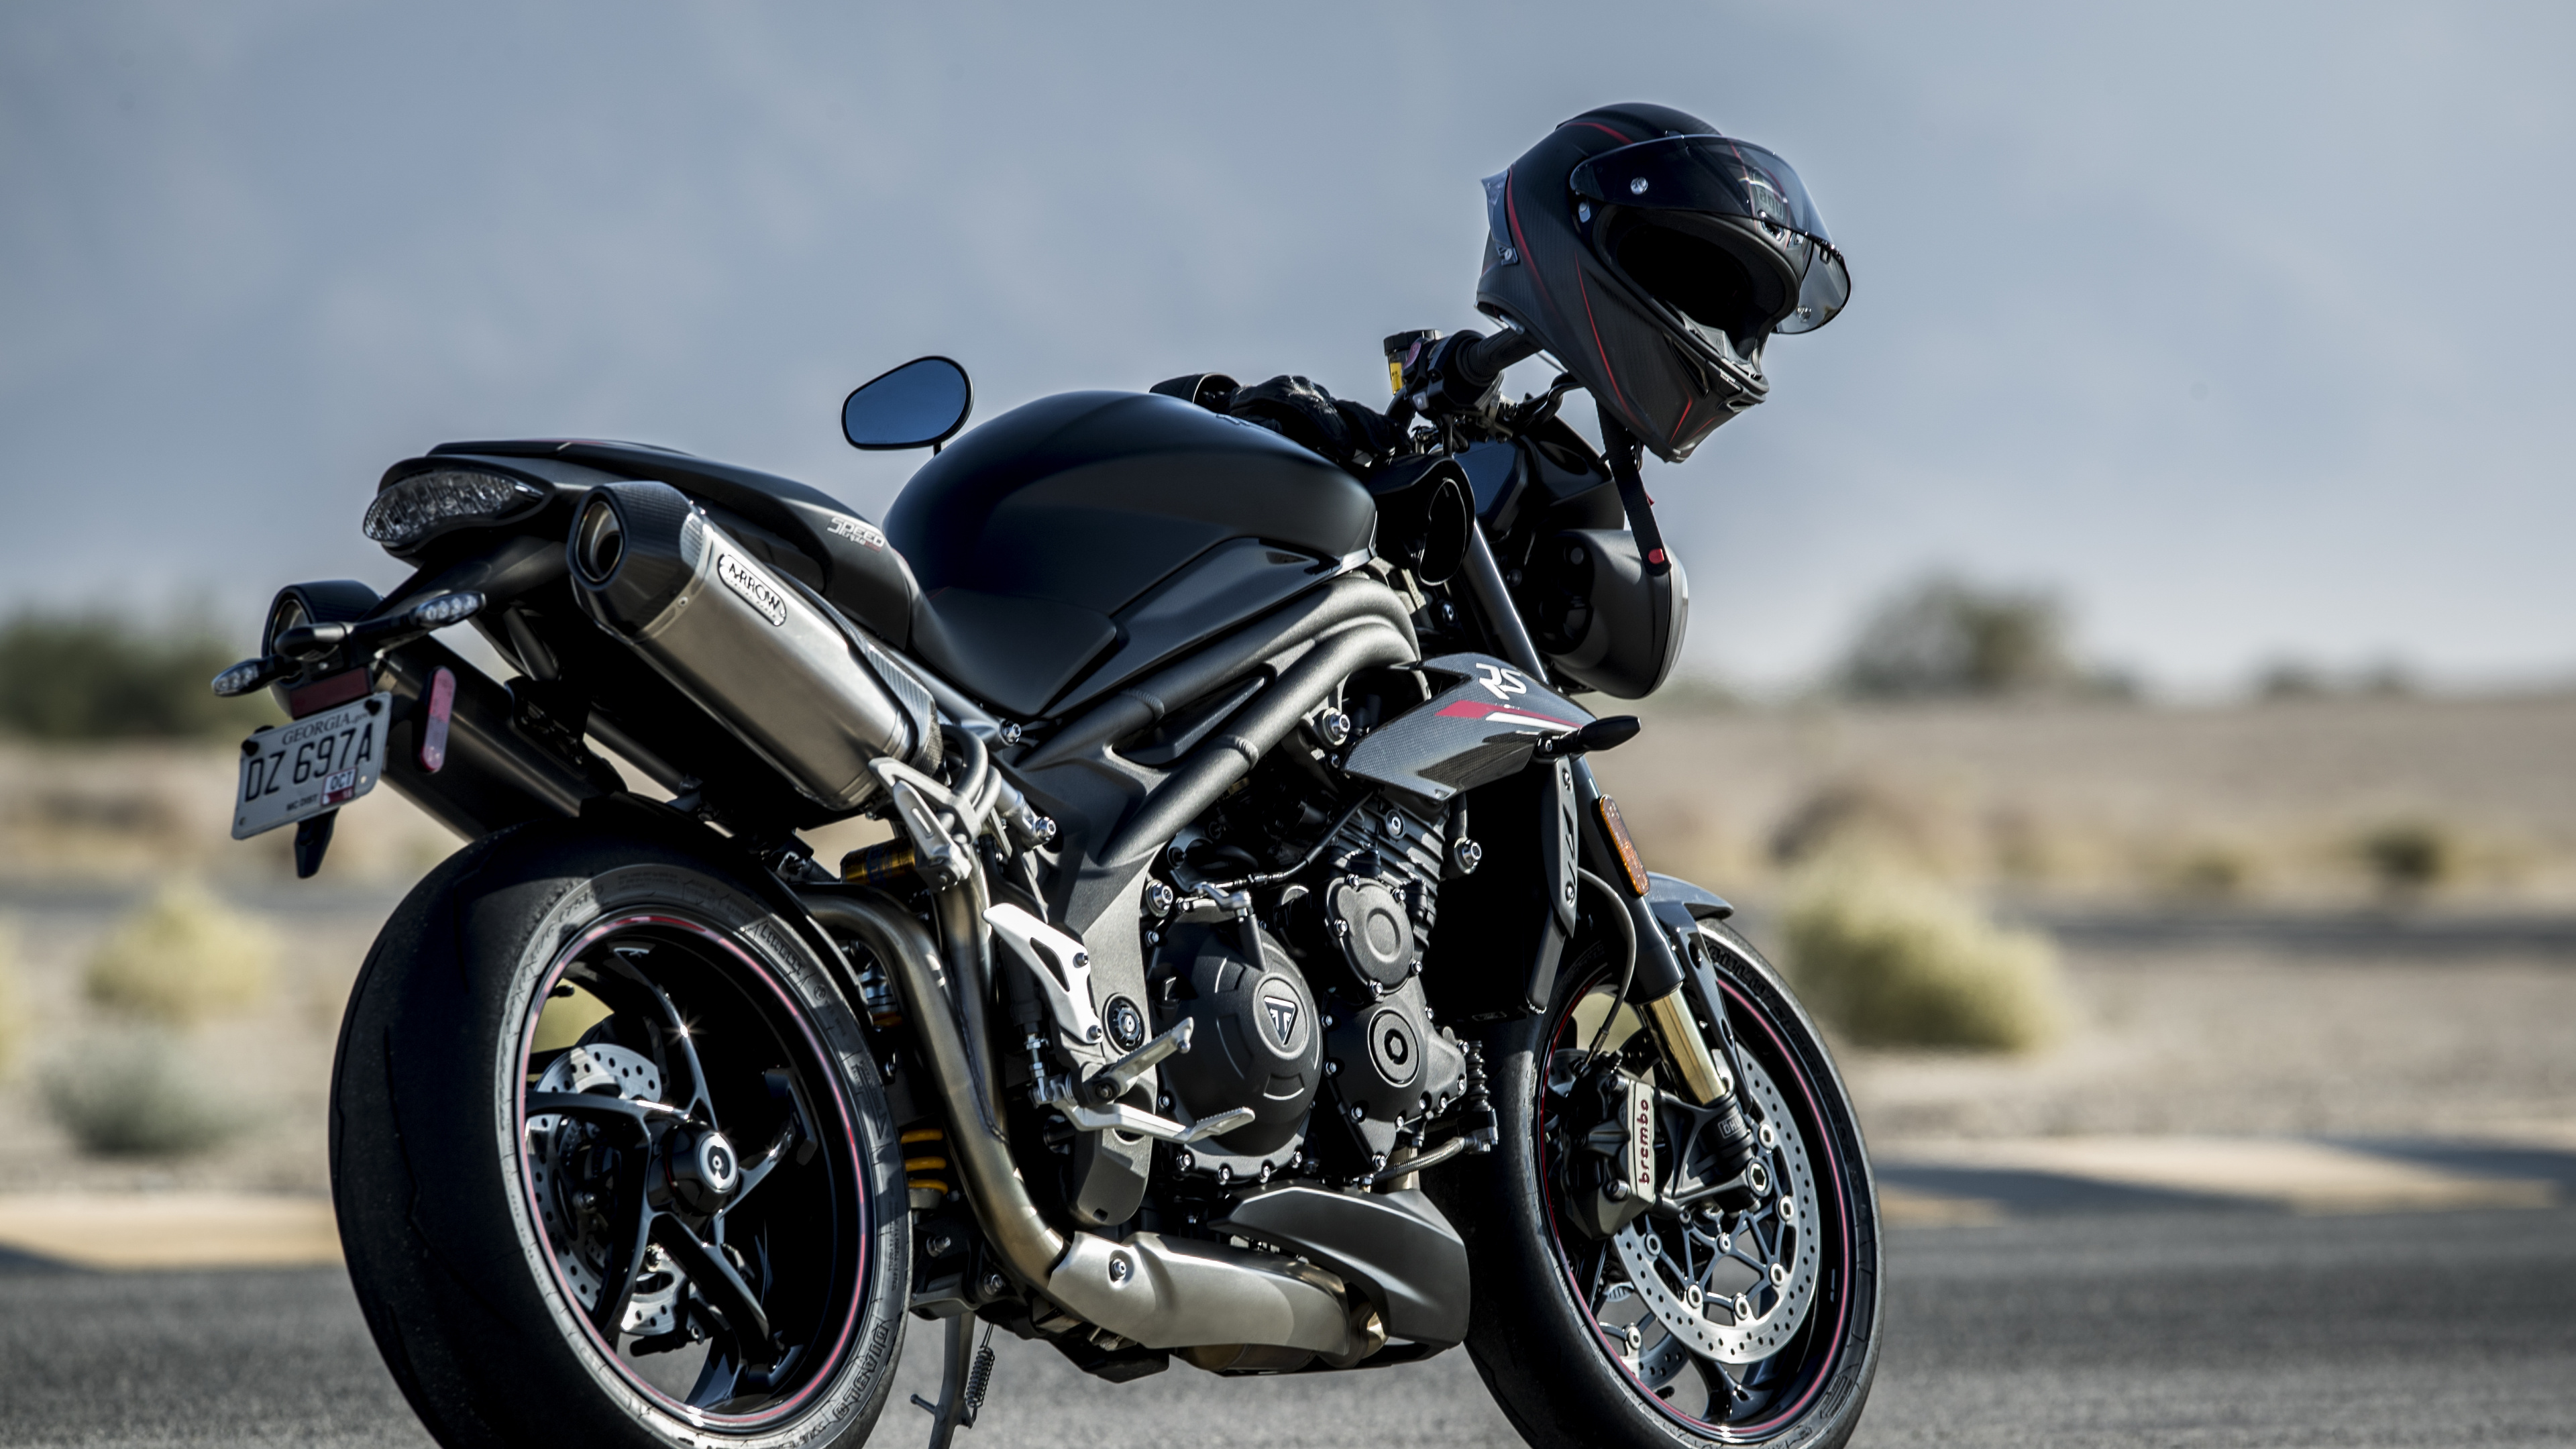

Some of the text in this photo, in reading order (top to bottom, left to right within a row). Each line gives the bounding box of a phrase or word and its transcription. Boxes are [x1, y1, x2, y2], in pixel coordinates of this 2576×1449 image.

[826, 517, 885, 547] SPEED
[729, 563, 780, 610] ARROW
[1476, 662, 1527, 700] RS
[245, 722, 373, 802] DZ 697A
[331, 771, 352, 790] OCT
[1636, 1099, 1651, 1186] brembo
